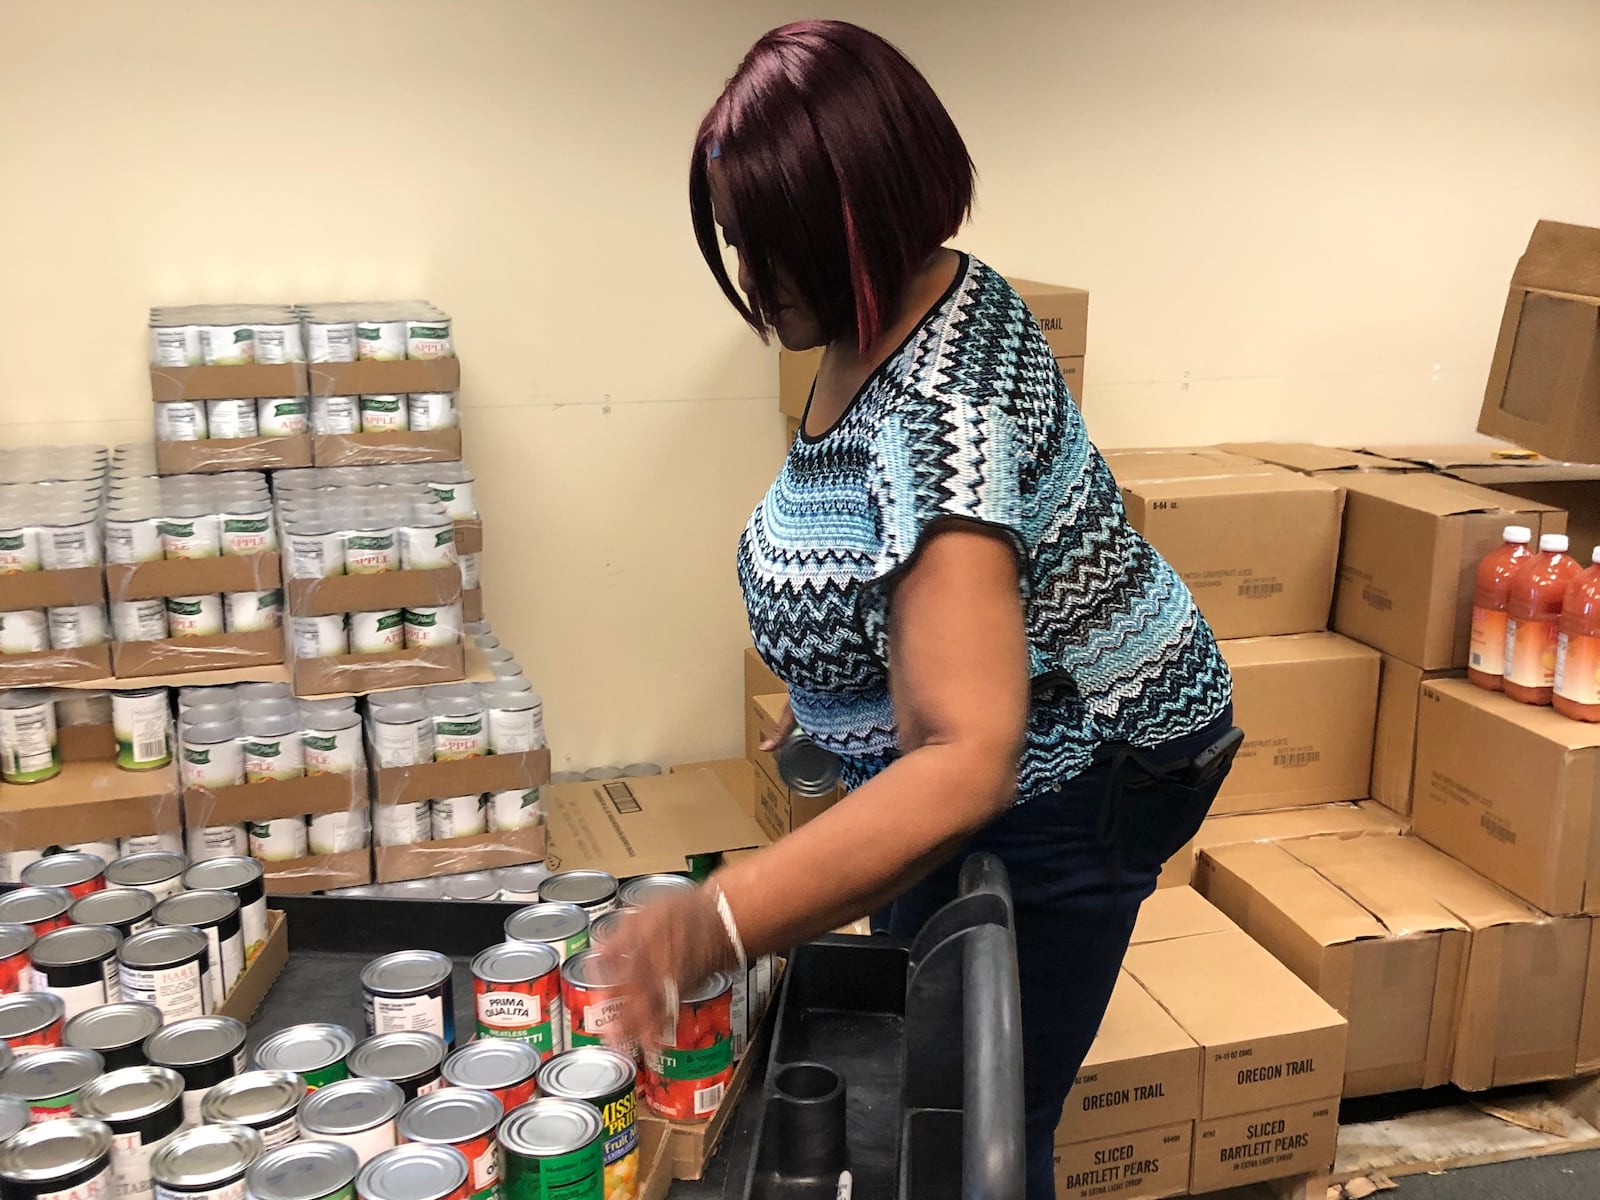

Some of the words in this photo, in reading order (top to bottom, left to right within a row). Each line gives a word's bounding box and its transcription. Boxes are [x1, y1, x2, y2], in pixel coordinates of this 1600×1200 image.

[1040, 317, 1063, 331] TRAIL
[415, 342, 447, 352] APPLE
[485, 1007, 530, 1018] QUALITA
[489, 998, 525, 1008] PRIMA
[1237, 1064, 1282, 1085] OREGON
[1286, 1058, 1315, 1077] TRAIL
[1083, 1089, 1129, 1111] OREGON
[1134, 1082, 1165, 1101] TRAIL
[1247, 1119, 1285, 1139] SLICED
[1094, 1145, 1134, 1165] SLICED
[1220, 1140, 1272, 1162] BARTLETT
[1275, 1133, 1309, 1153] PEARS
[1066, 1166, 1120, 1190] BARTLETT
[1123, 1159, 1159, 1178] PEARS
